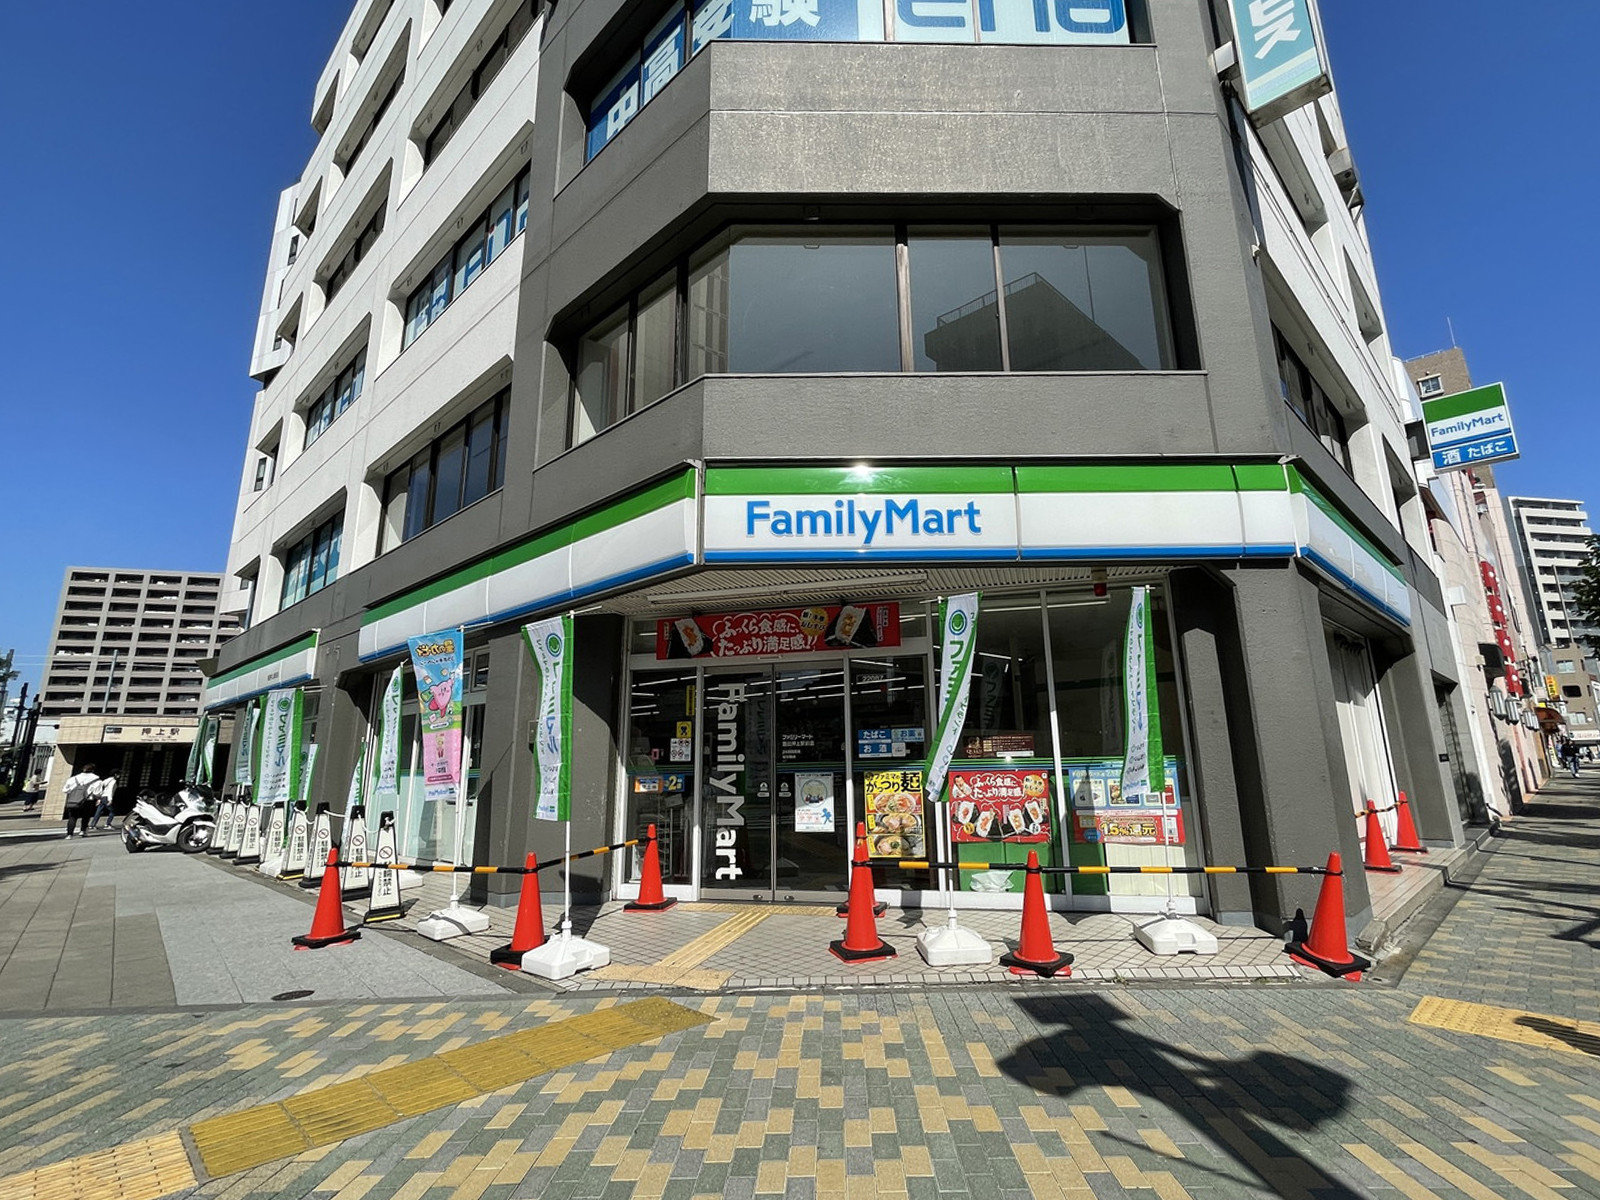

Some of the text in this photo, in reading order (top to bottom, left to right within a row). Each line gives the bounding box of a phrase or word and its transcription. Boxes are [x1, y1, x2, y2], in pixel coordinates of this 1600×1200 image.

[1431, 413, 1504, 437] FamilyMart
[1442, 441, 1508, 465] 酒 たばこ
[746, 499, 982, 545] FamilyMart
[863, 730, 886, 739] たばこ
[709, 683, 747, 881] FamilyMart
[866, 771, 921, 792] がっつり 麺
